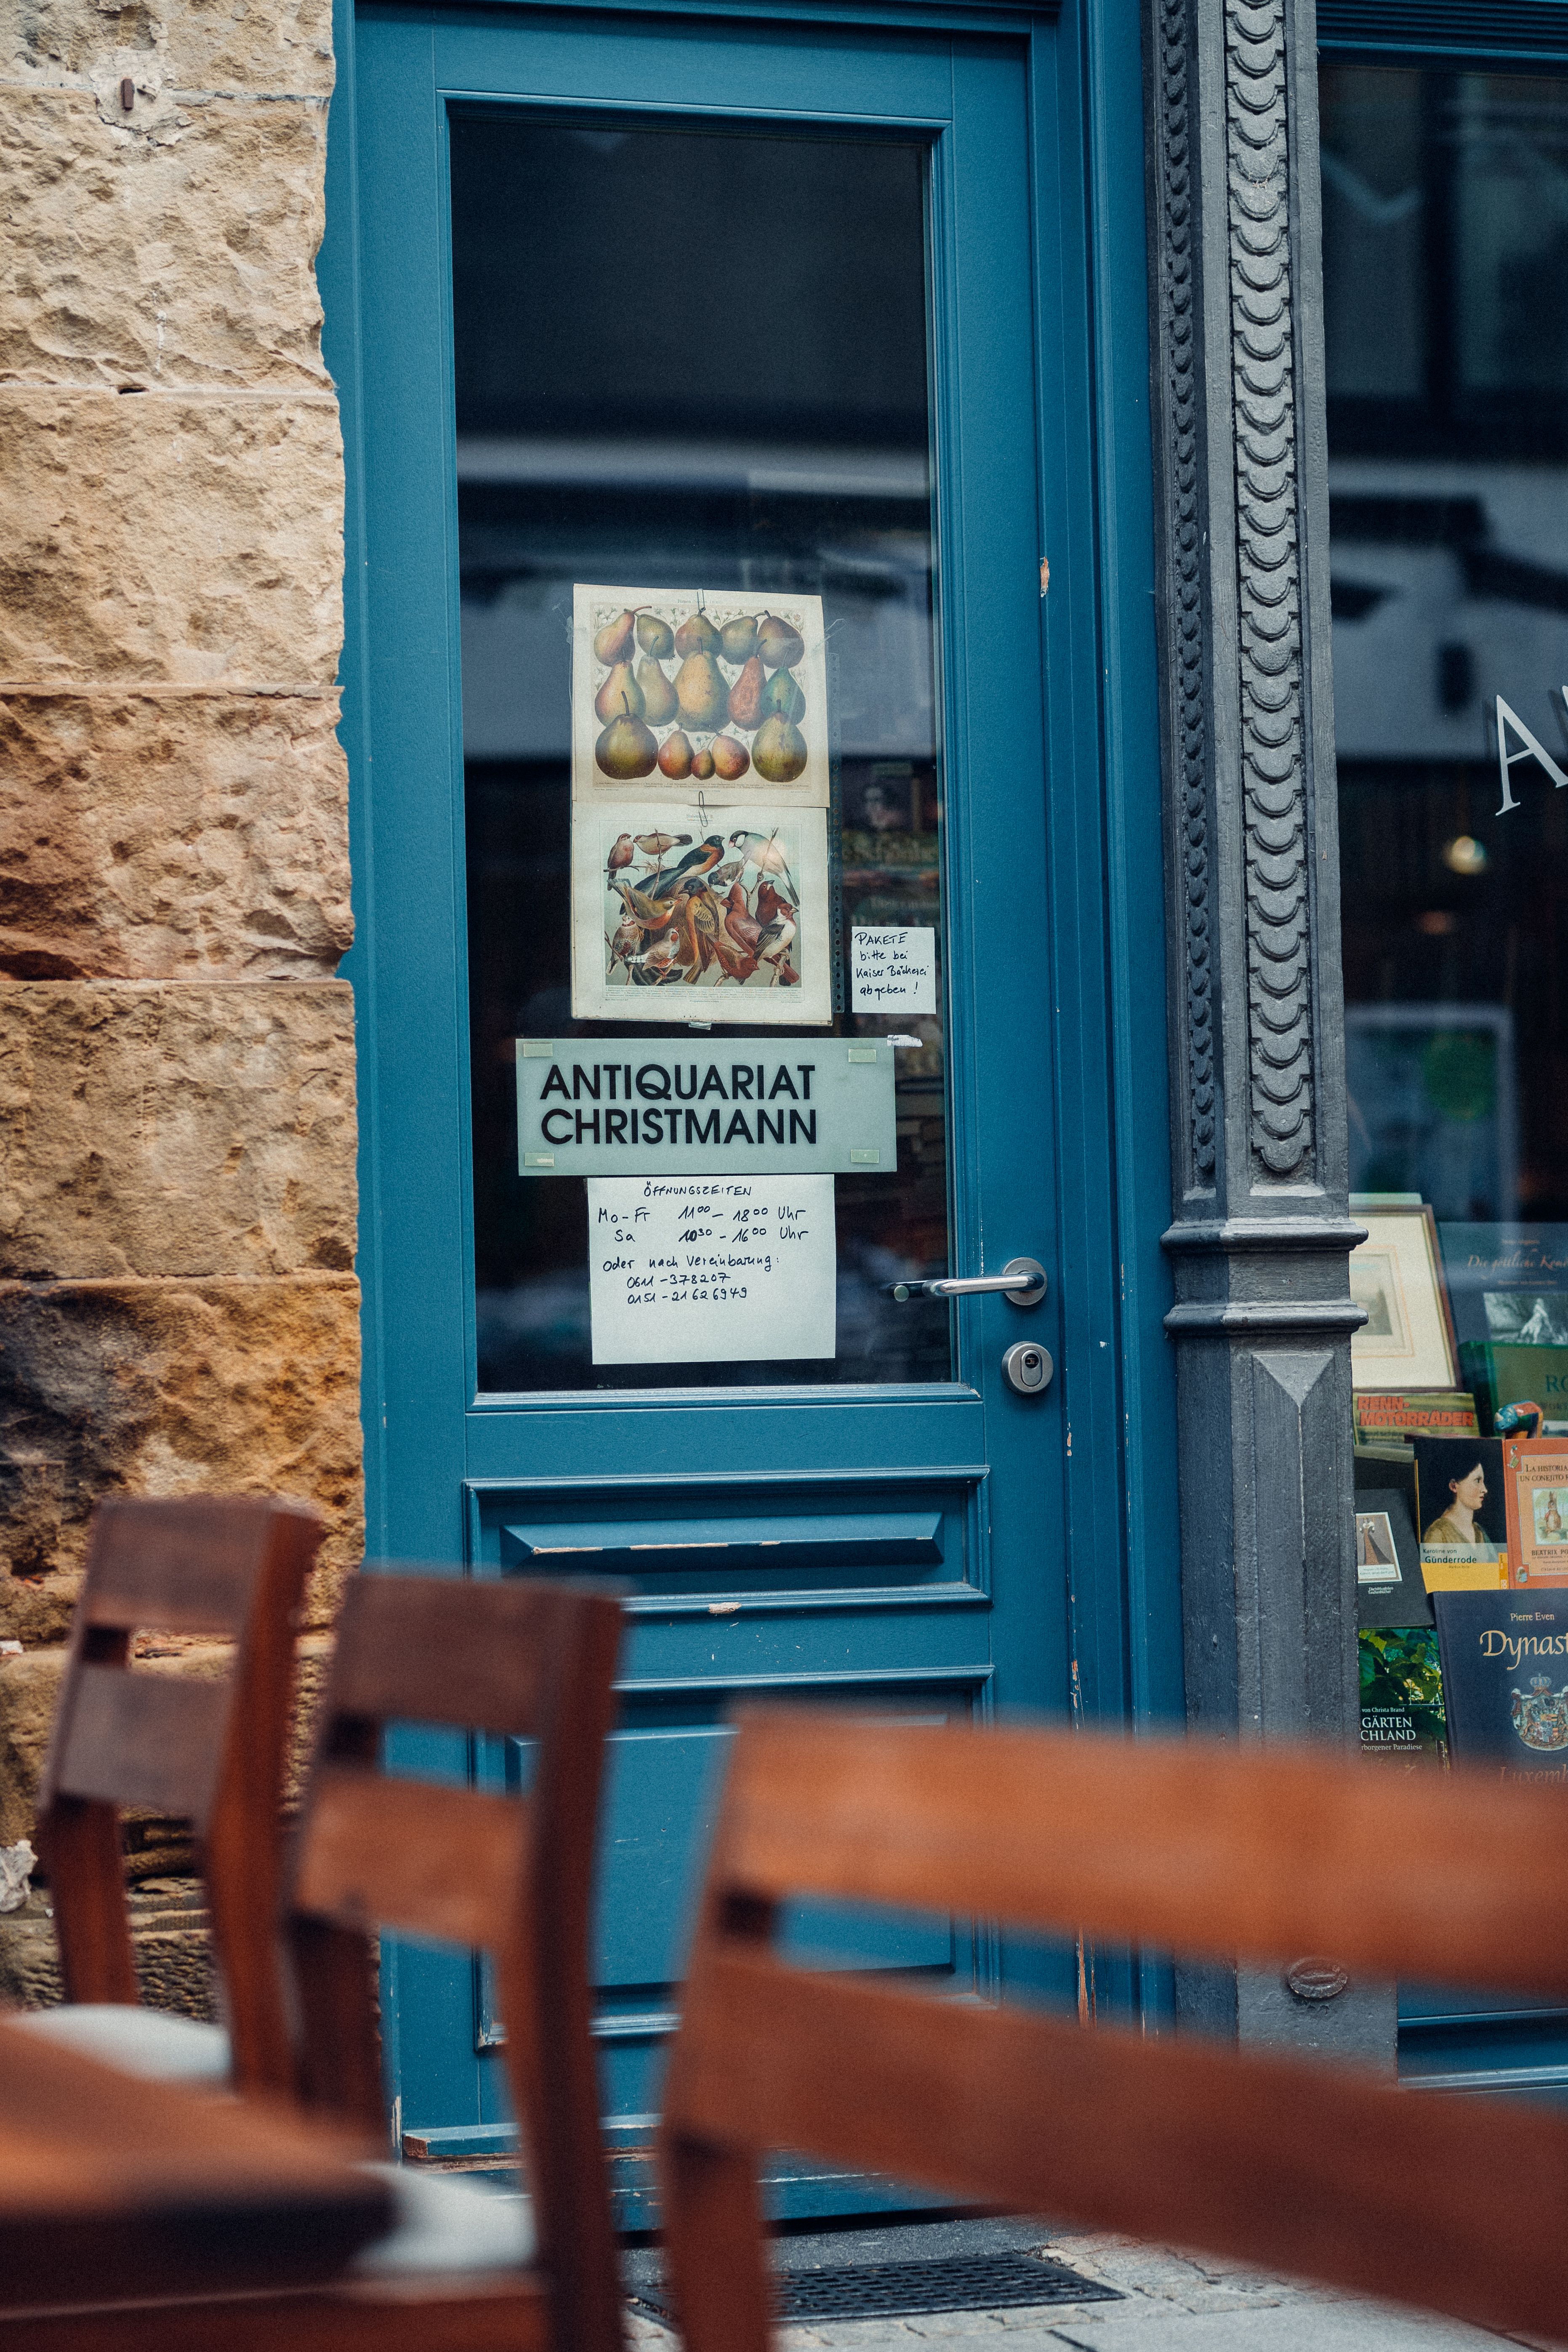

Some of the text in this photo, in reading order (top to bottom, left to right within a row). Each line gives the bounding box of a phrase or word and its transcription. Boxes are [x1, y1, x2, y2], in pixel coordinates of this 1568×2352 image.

[854, 932, 908, 946] PAKETE
[860, 949, 908, 961] bitte bei
[856, 965, 929, 979] Kaiser Bäckerei
[539, 1063, 816, 1100] ANTIQUARIAT
[541, 1108, 817, 1145] CHRISTMANN
[644, 1180, 752, 1196] ÖFFNUNGSZEITEN
[778, 1206, 806, 1220] Uhr
[615, 1230, 636, 1242] Sa
[780, 1225, 809, 1240] Uhr
[649, 1255, 679, 1268] nach
[1535, 1612, 1555, 1620] Even
[1362, 1715, 1412, 1728] GÄRTEN
